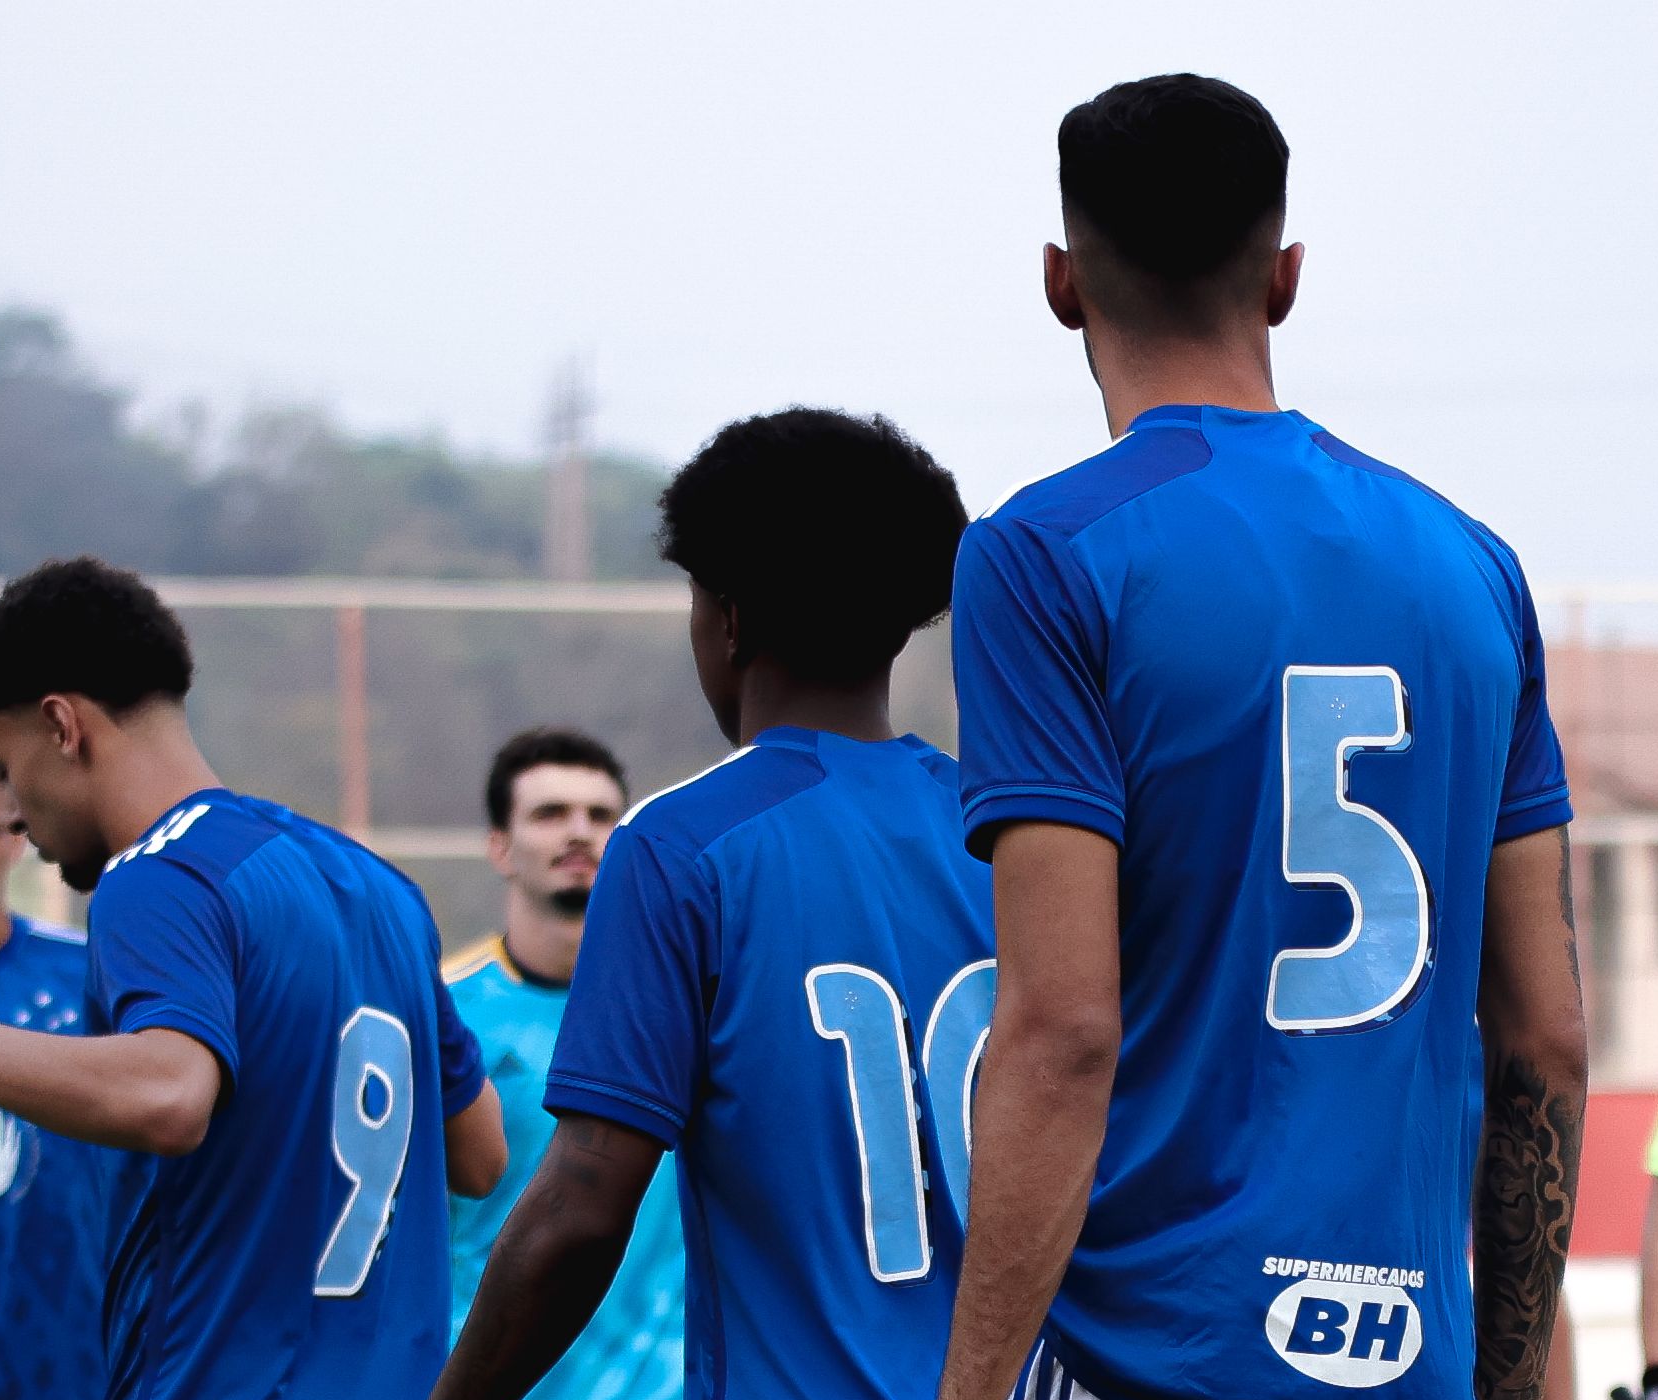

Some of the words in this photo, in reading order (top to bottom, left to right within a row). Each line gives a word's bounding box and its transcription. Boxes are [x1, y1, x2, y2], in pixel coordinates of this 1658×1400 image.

[1266, 665, 1431, 1032] 5
[313, 1007, 414, 1297] 9
[1262, 1256, 1425, 1289] SUPERMERCADOS
[1285, 1295, 1410, 1362] BH
